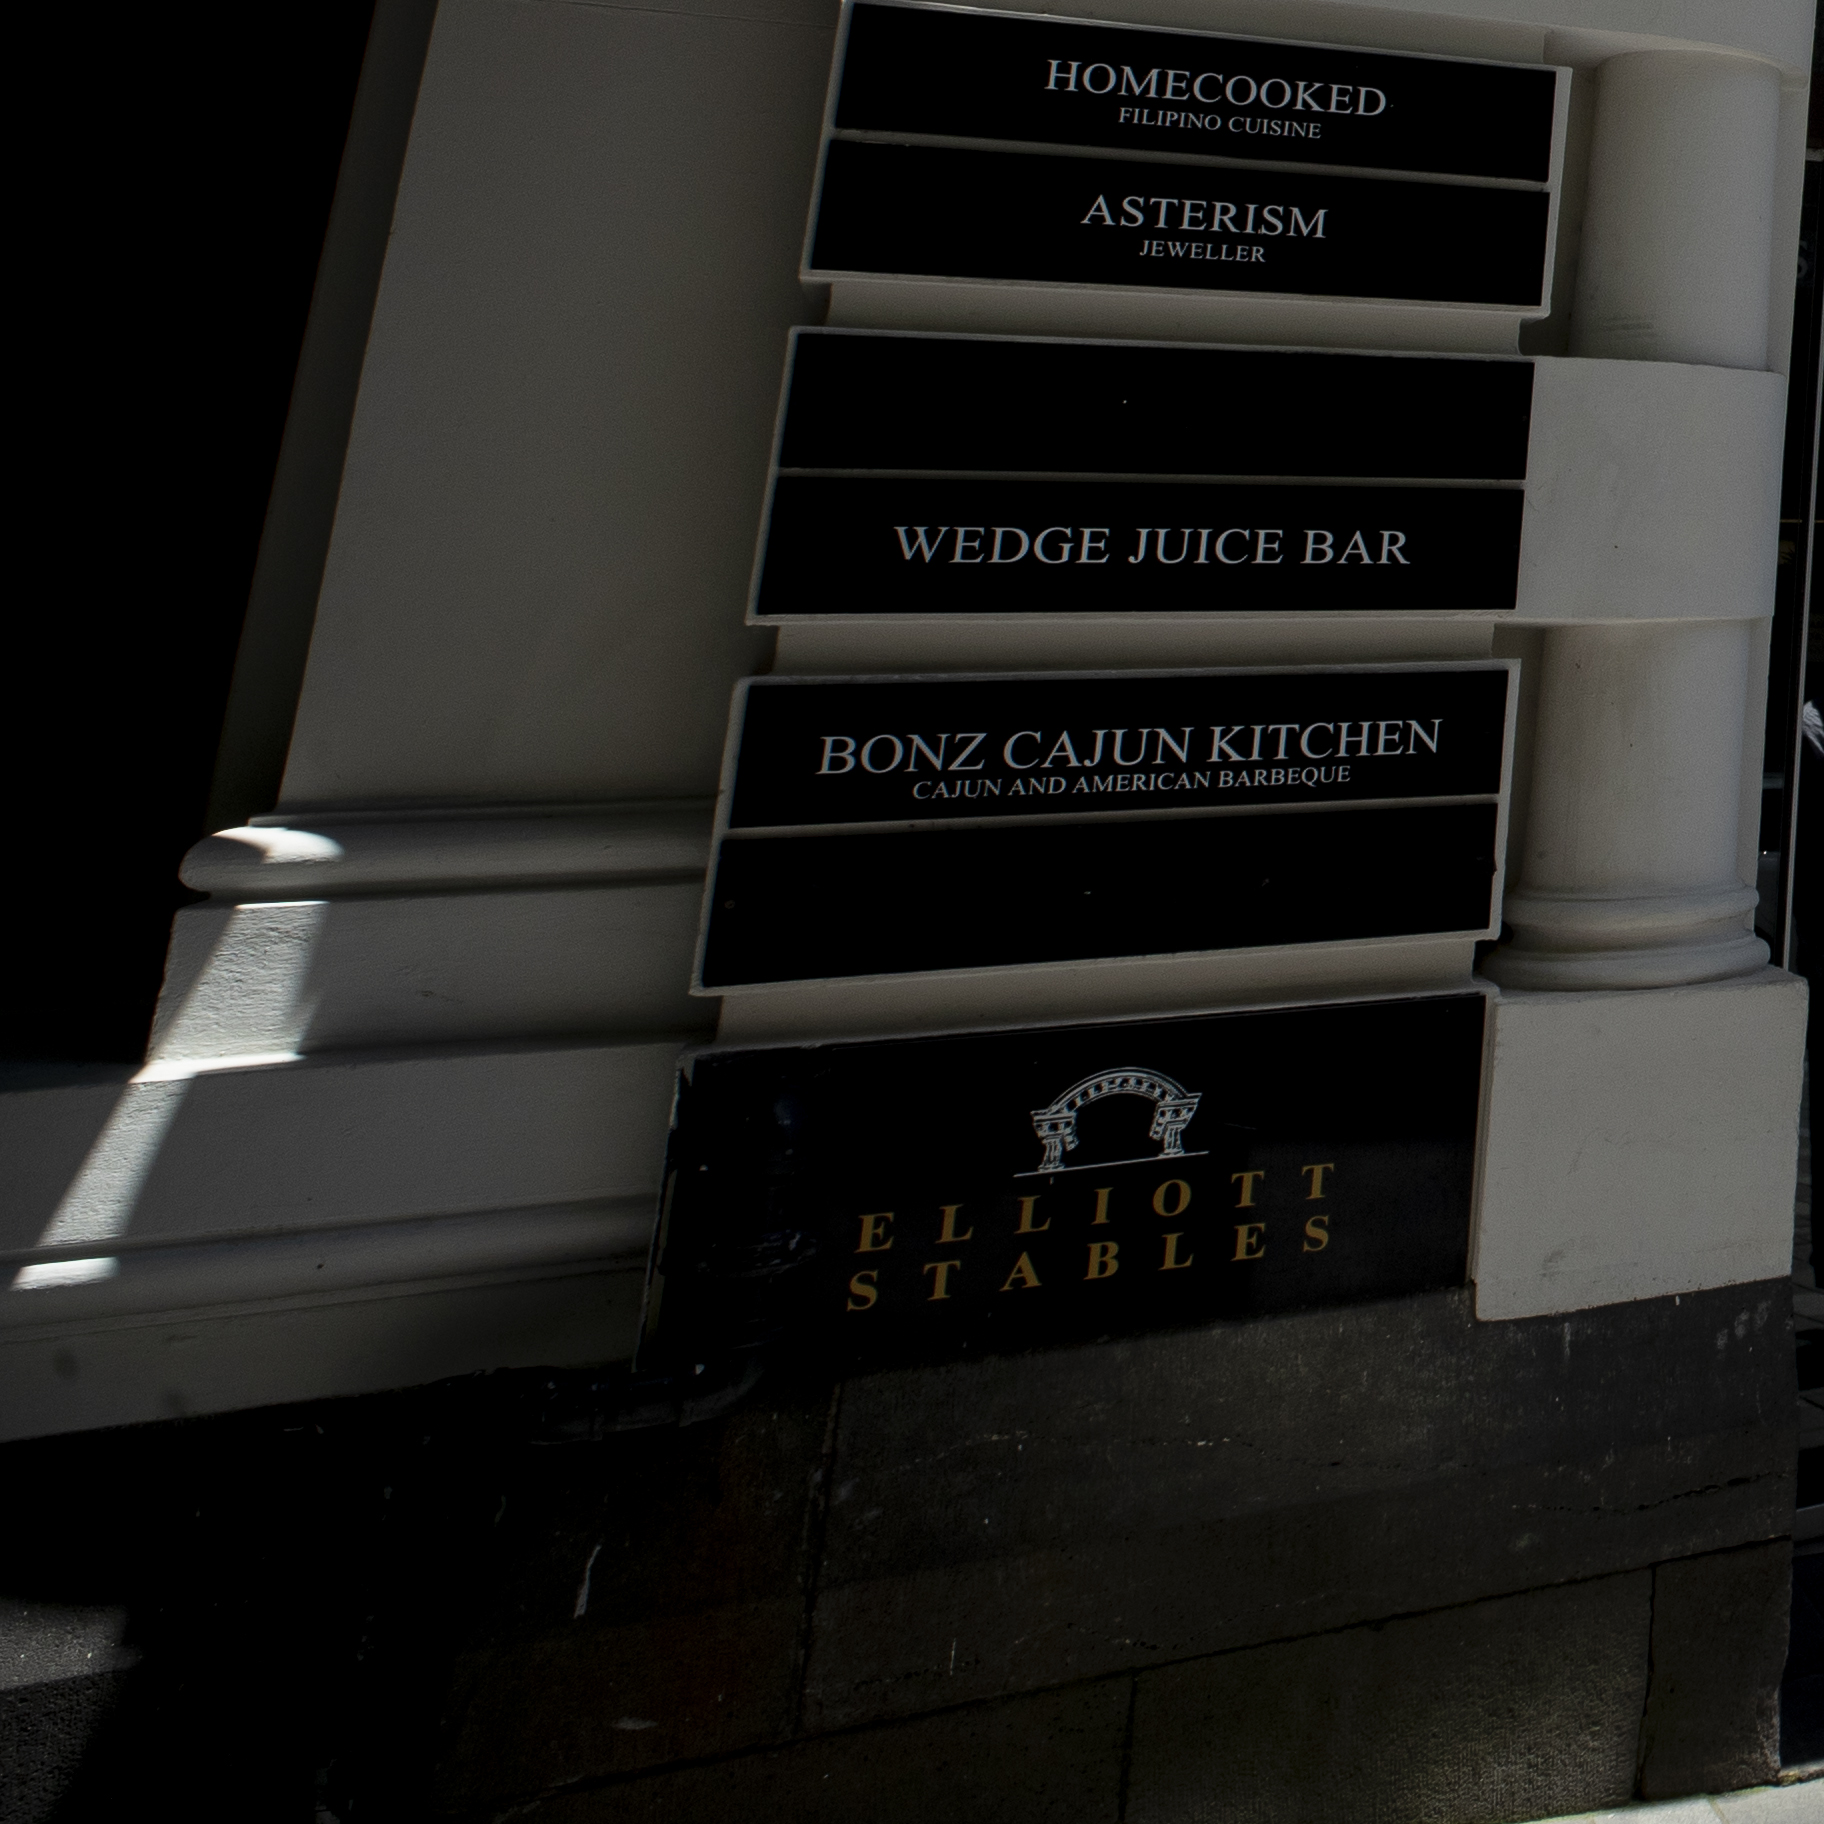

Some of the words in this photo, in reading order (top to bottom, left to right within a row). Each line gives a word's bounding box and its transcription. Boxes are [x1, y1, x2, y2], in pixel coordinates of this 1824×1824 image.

[1044, 59, 1387, 118] HOMECOOKED
[1118, 106, 1223, 132] FILIPINO
[1228, 116, 1322, 140] CUISINE
[1080, 194, 1328, 240] ASTERISM
[1139, 239, 1266, 263] JEWELLER
[893, 525, 1111, 565] WEDGE
[1128, 527, 1285, 566] JUICE
[1300, 529, 1410, 567] BAR
[816, 732, 988, 775] BONZ
[1002, 725, 1194, 768] CAJUN
[1208, 718, 1443, 764] KITCHEN
[912, 779, 1001, 800] CAJUN
[1008, 776, 1067, 796] AND
[1072, 771, 1212, 793] AMERICAN
[1217, 765, 1351, 790] BARBEQUE
[855, 1162, 1336, 1254] ELLIOTT
[846, 1216, 1332, 1312] STABLES
